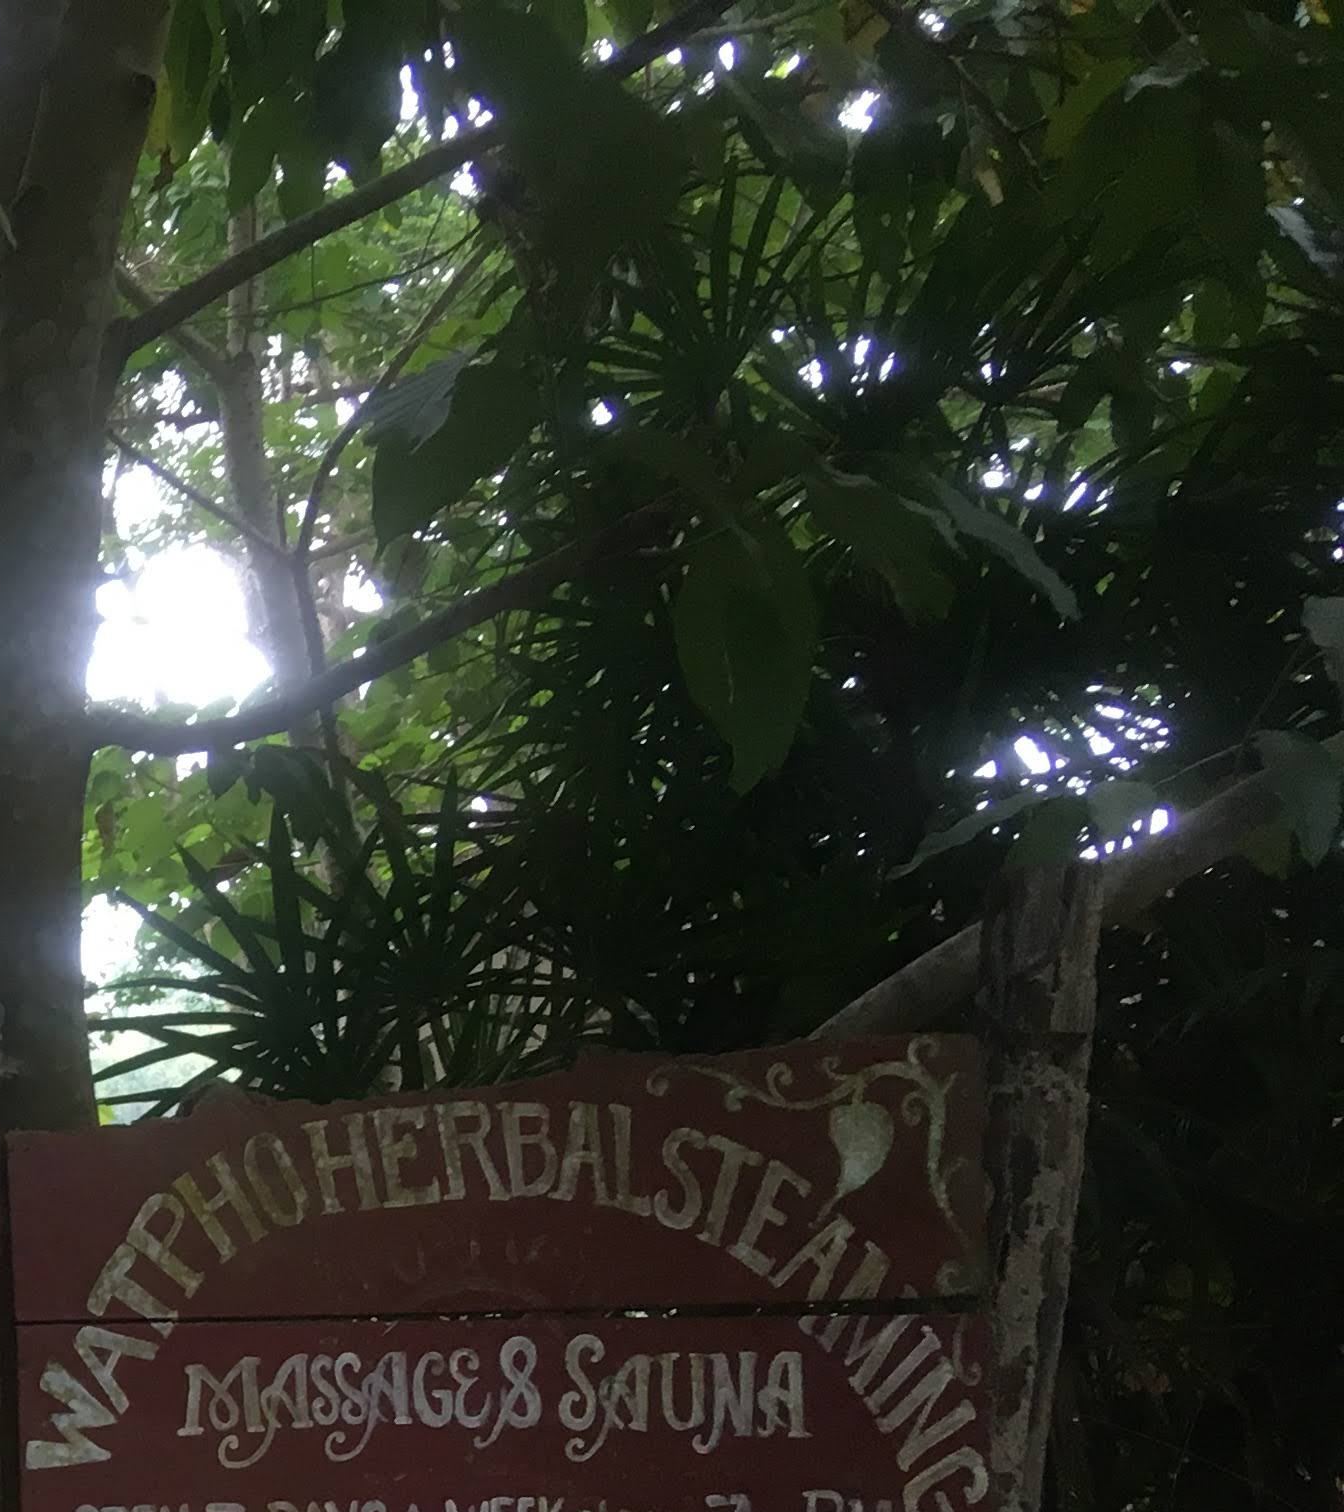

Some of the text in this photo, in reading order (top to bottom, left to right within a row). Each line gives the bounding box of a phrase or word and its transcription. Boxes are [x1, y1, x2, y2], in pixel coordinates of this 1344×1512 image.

[301, 1099, 653, 1217] HERBAL
[176, 1347, 493, 1470] MASSAGE
[558, 1332, 813, 1463] SAUNA
